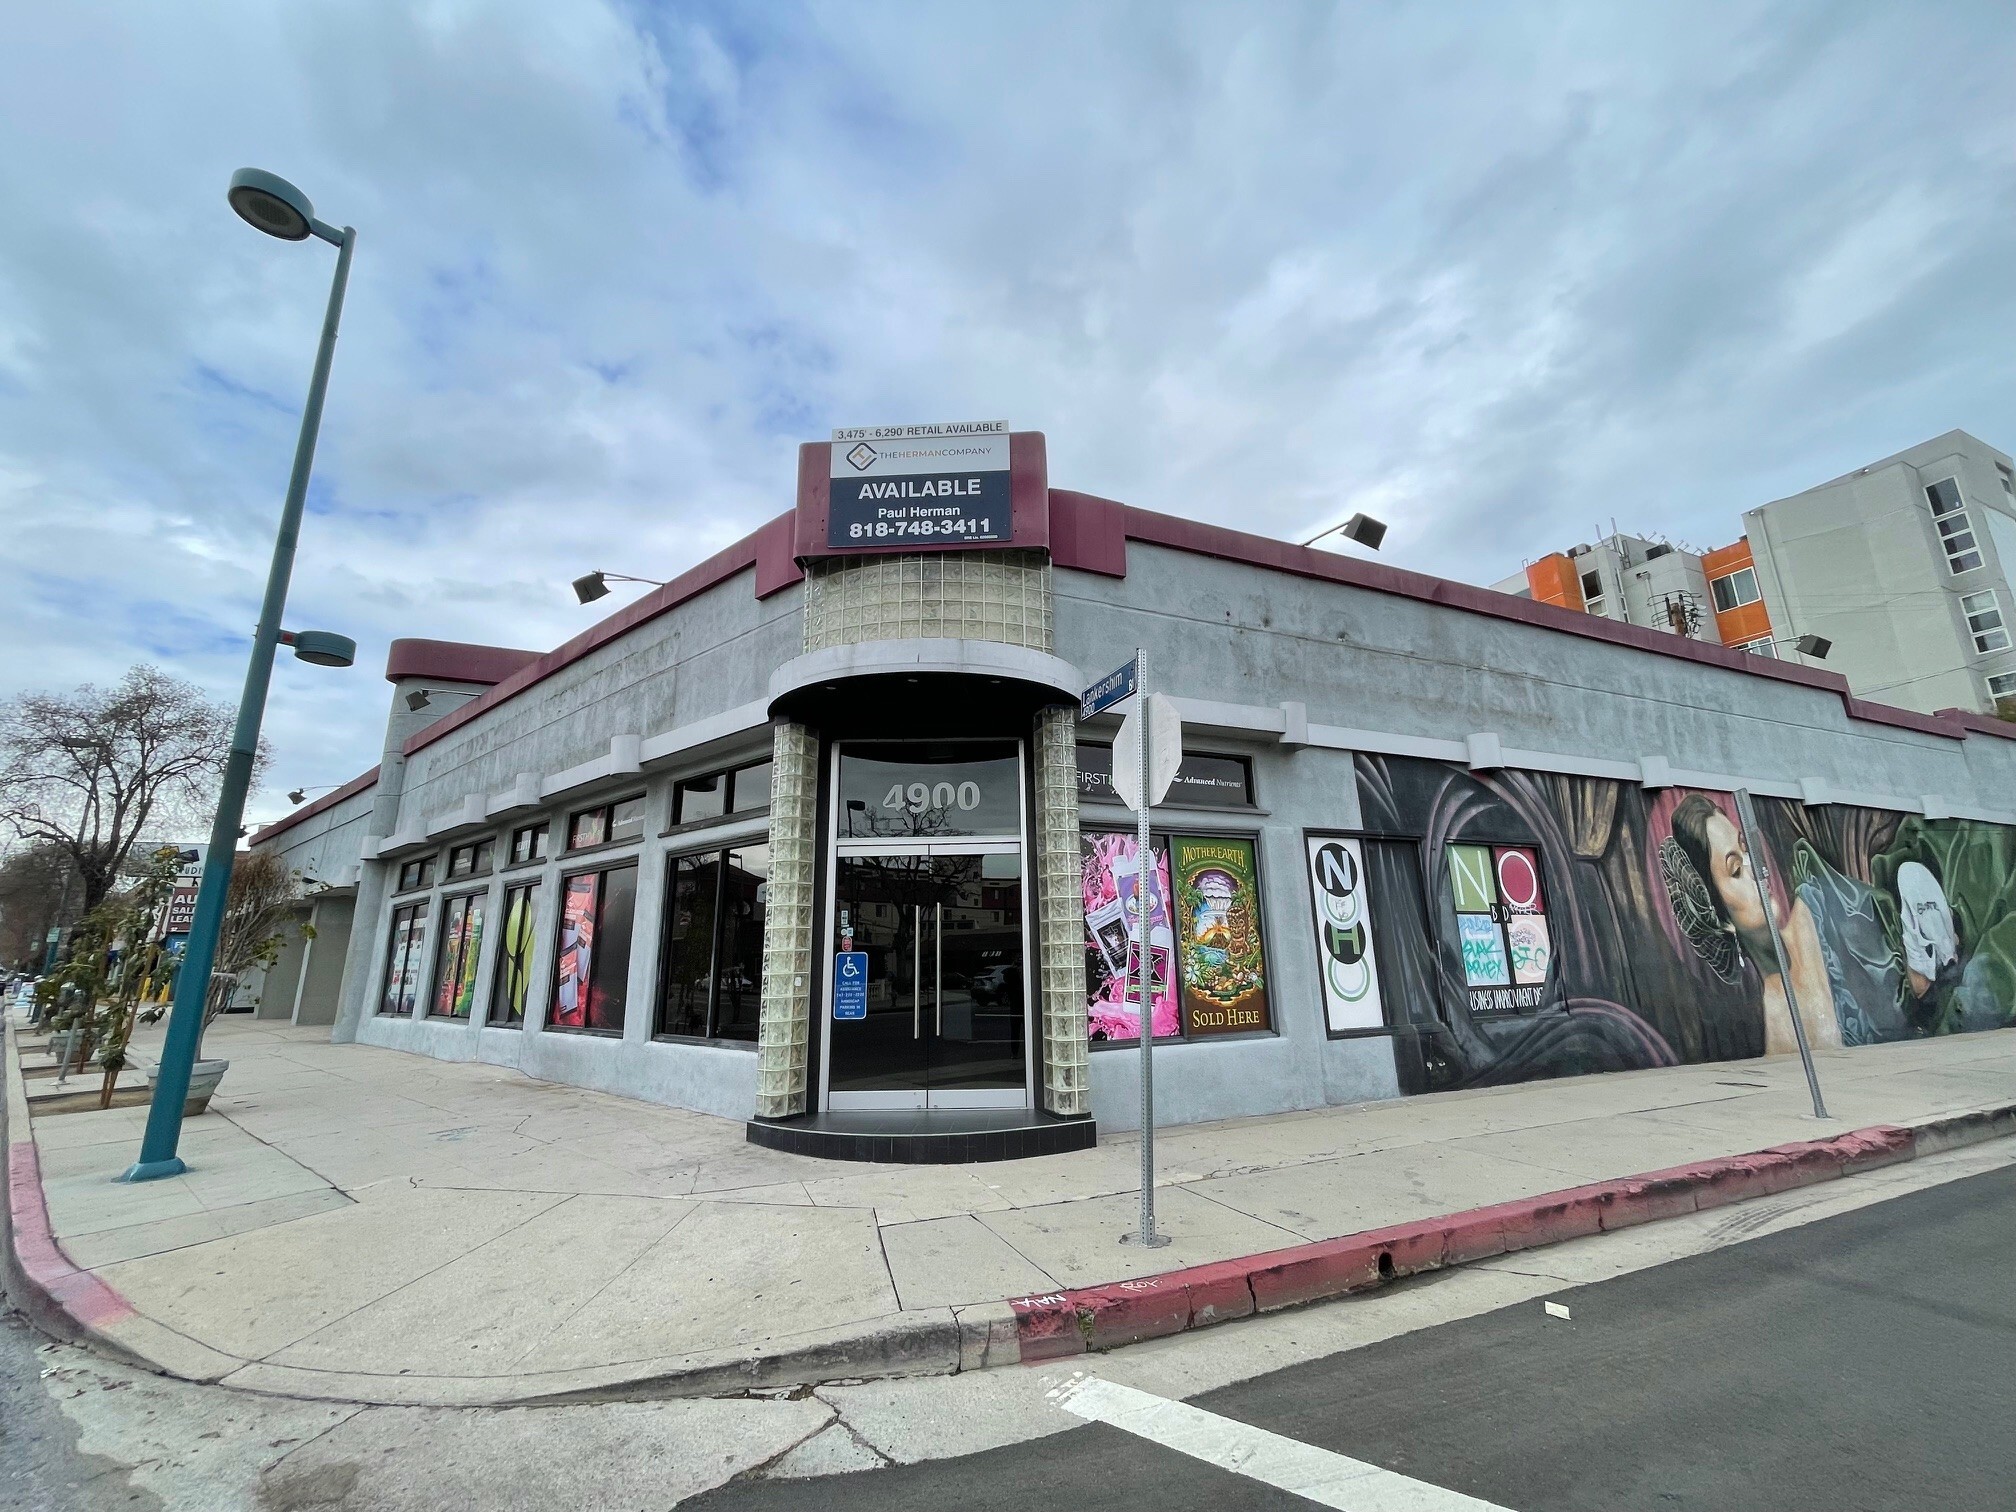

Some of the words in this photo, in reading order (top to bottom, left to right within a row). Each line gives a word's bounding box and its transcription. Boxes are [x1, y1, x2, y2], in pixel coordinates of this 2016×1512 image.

[907, 425, 943, 436] RETAIL
[945, 422, 1003, 434] AVAILABLE
[858, 479, 982, 500] AVAILABLE
[878, 508, 906, 519] Paul
[910, 506, 960, 517] Herman
[849, 518, 990, 538] 818-748-3411
[1083, 672, 1123, 708] Lankershim
[1184, 776, 1215, 786] Advanced
[882, 781, 981, 814] 4900
[1181, 846, 1217, 866] MOTHER
[1217, 847, 1245, 868] EARTH
[1193, 1009, 1224, 1028] SOLD
[1226, 1008, 1260, 1026] HERE
